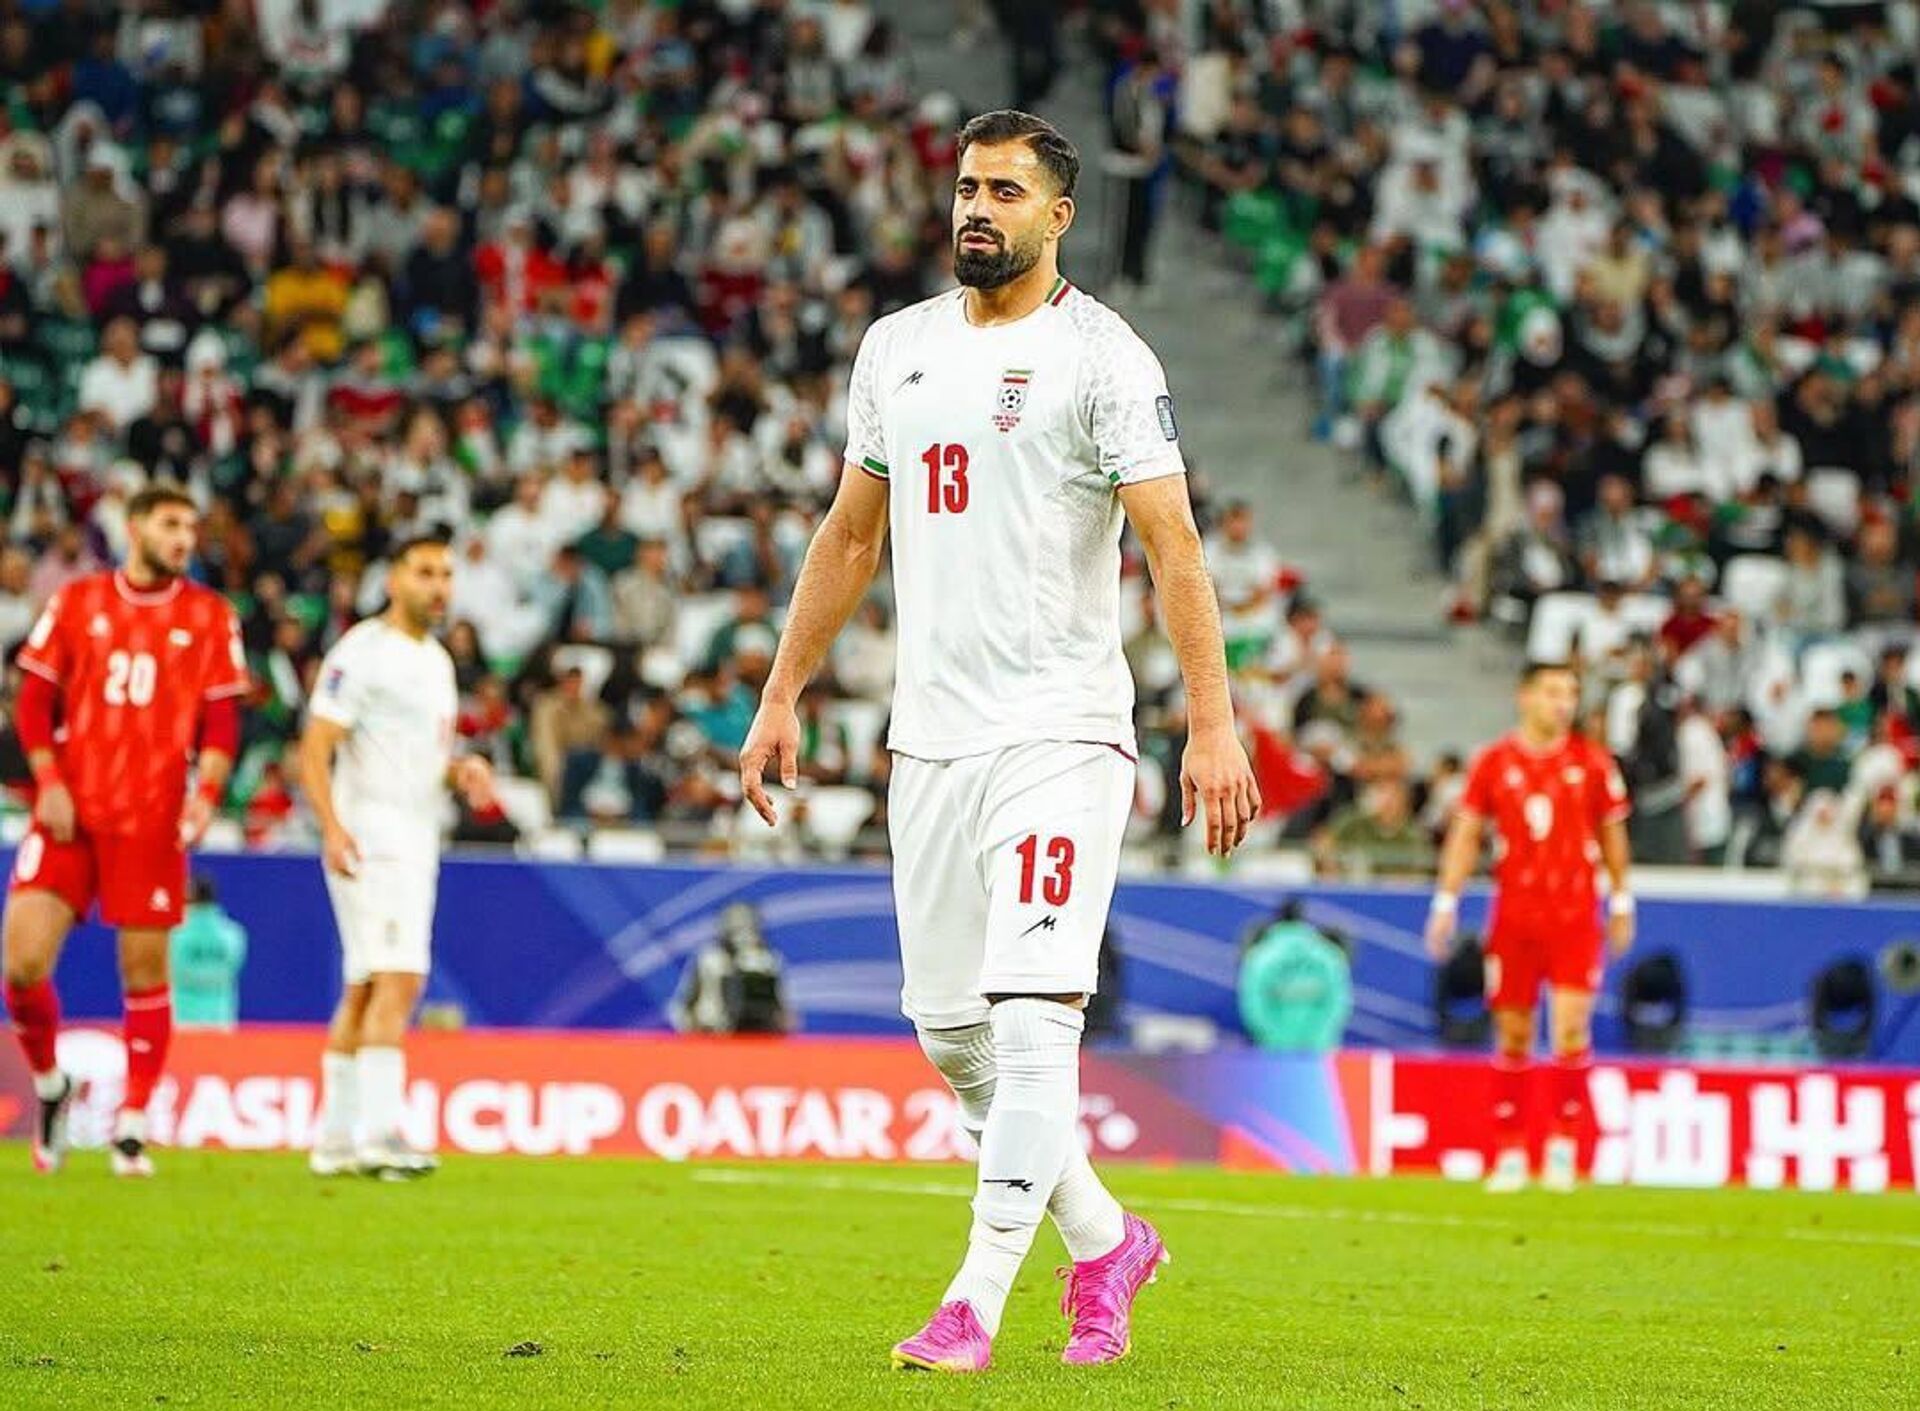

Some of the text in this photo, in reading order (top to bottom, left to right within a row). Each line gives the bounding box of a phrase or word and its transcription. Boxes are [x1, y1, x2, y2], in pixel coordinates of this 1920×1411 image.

[921, 442, 969, 514] 13
[103, 650, 157, 706] 20
[1523, 794, 1554, 841] 9
[1015, 834, 1075, 906] 13
[177, 1074, 439, 1150] ASIN
[445, 1080, 624, 1156] CUP
[636, 1083, 896, 1160] QATAR
